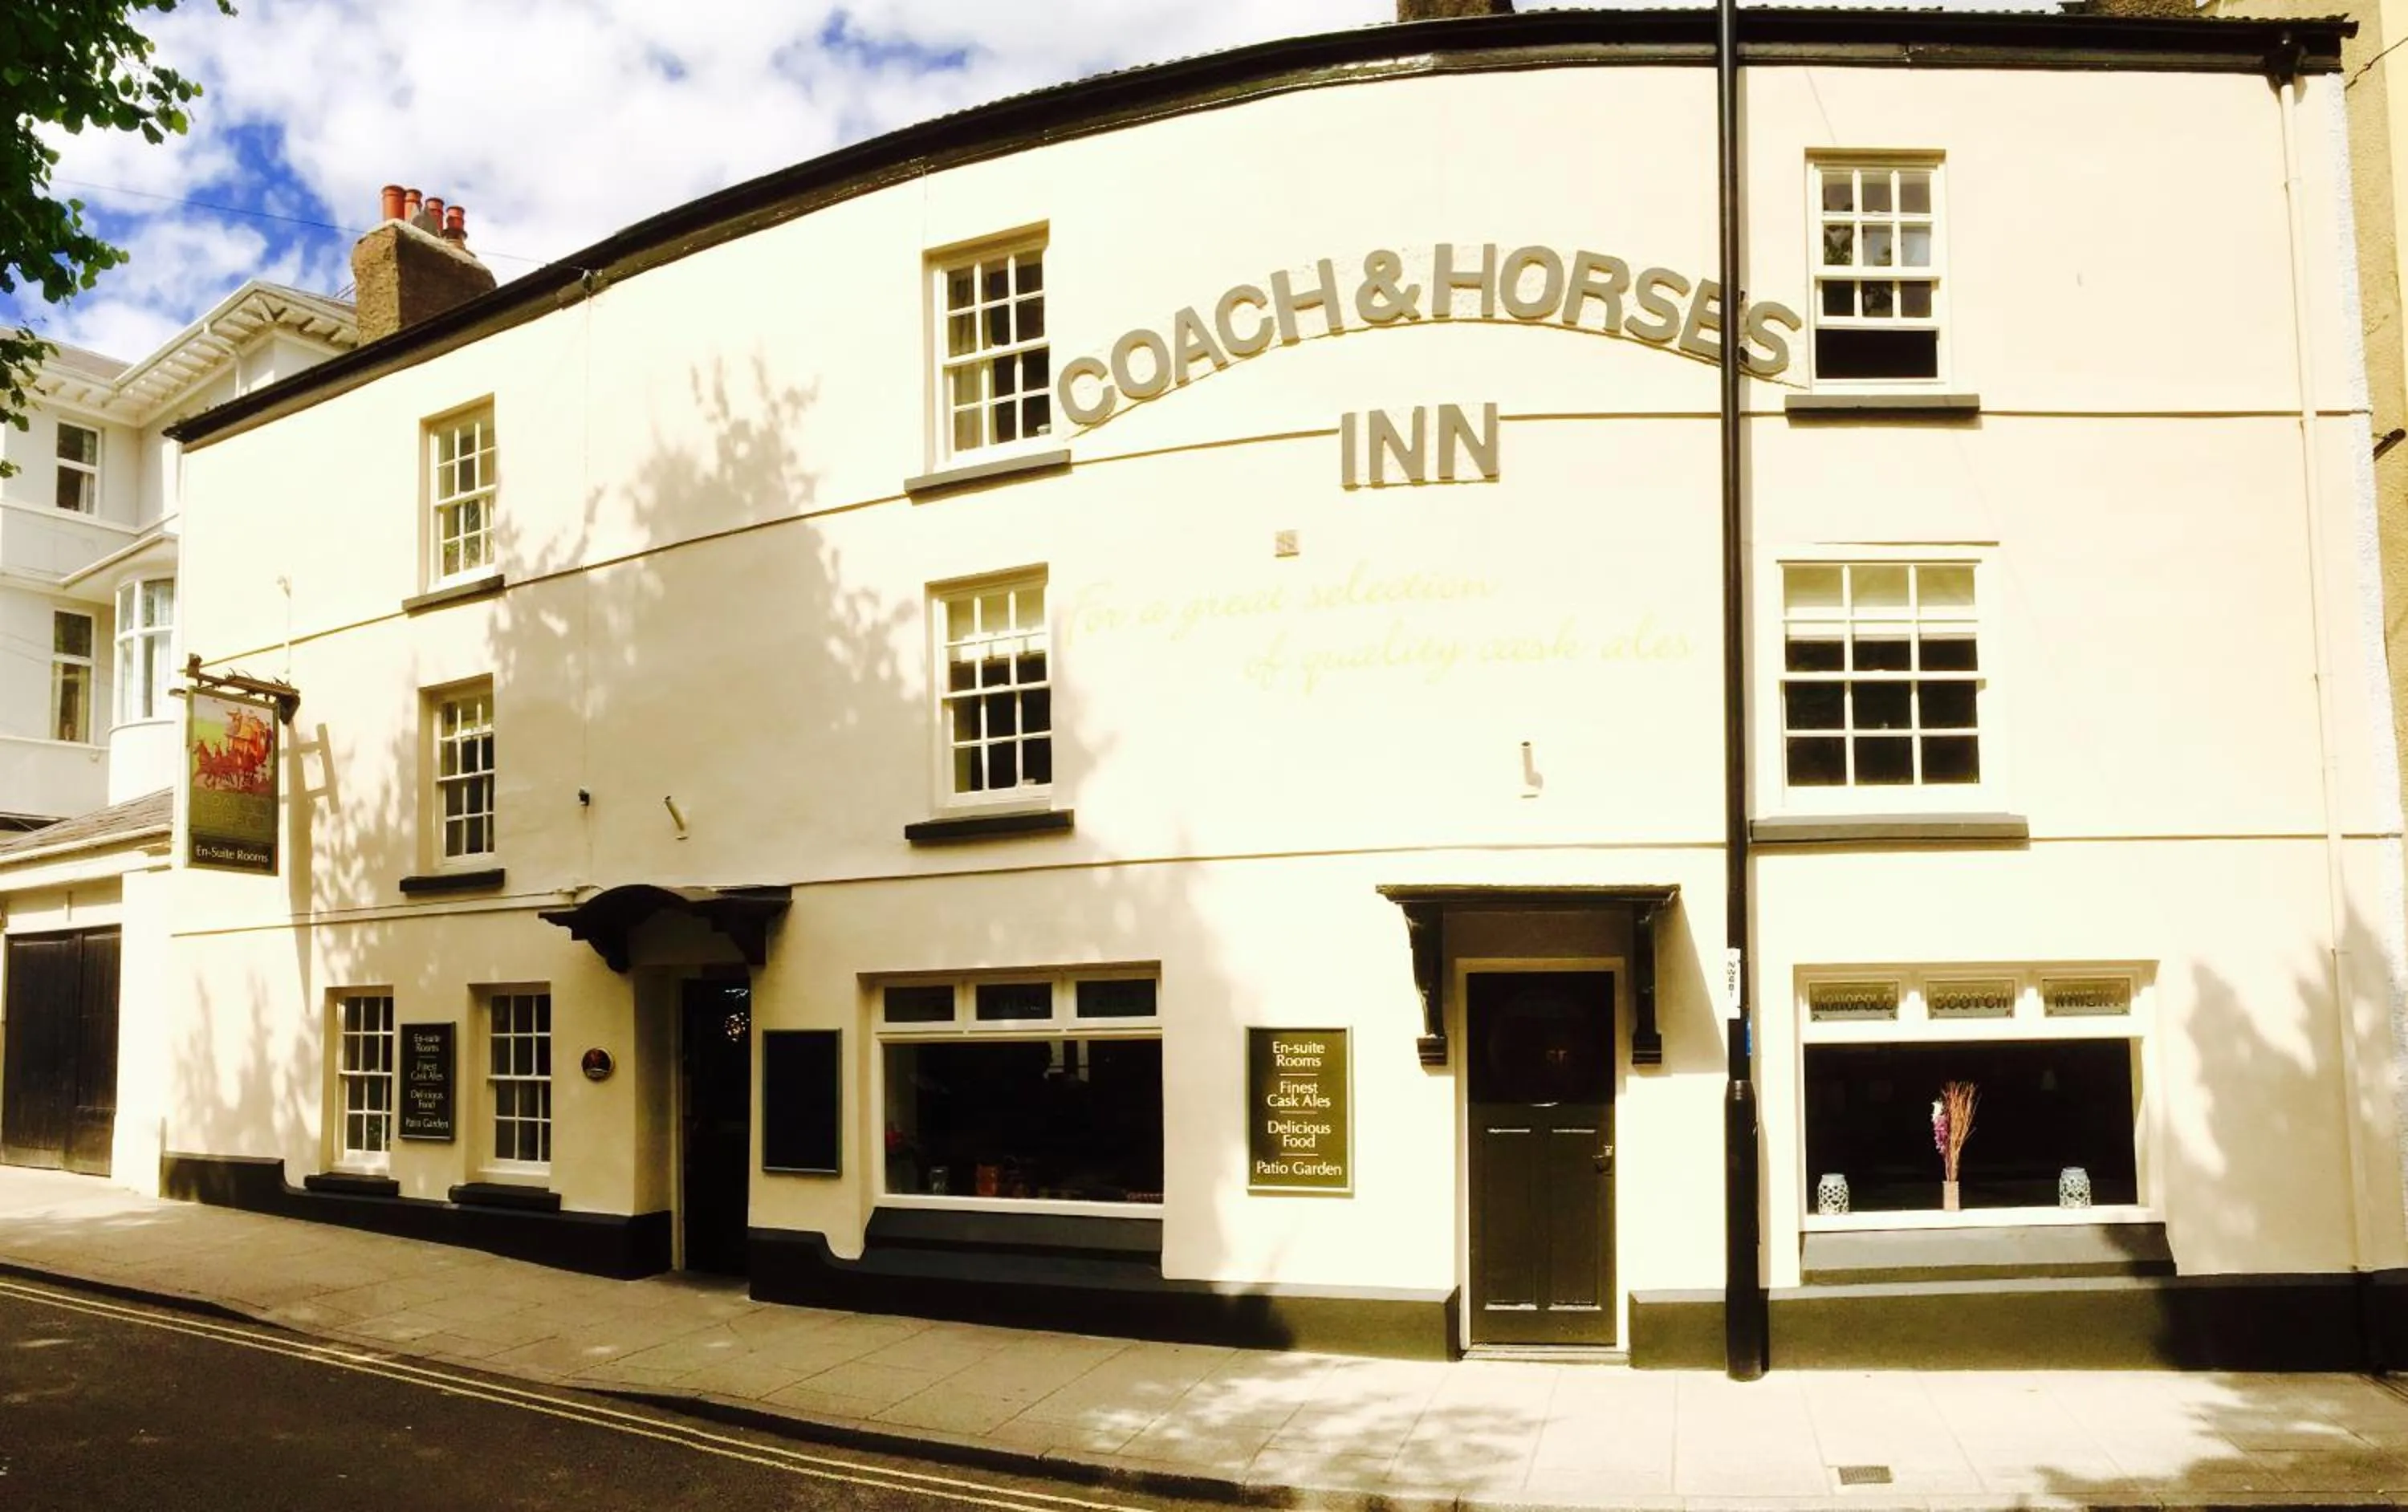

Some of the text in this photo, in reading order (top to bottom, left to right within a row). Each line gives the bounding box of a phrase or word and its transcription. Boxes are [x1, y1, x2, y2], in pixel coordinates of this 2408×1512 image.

[1058, 243, 1802, 425] COACH & HORSES
[1341, 403, 1499, 490] INN
[1069, 557, 1502, 642] For a great selection
[1243, 606, 1692, 697] of quality cask ales
[195, 844, 269, 863] En-Suite Rooms
[1934, 992, 2008, 1010] SCOTCH
[1272, 1041, 1325, 1054] En-suite
[1276, 1055, 1322, 1067] Rooms
[1279, 1081, 1319, 1094] Finest
[1267, 1094, 1331, 1108] Cask Ales
[1267, 1120, 1331, 1134] Delicious
[1283, 1134, 1316, 1148] Food
[1256, 1160, 1342, 1176] Patio Garden
